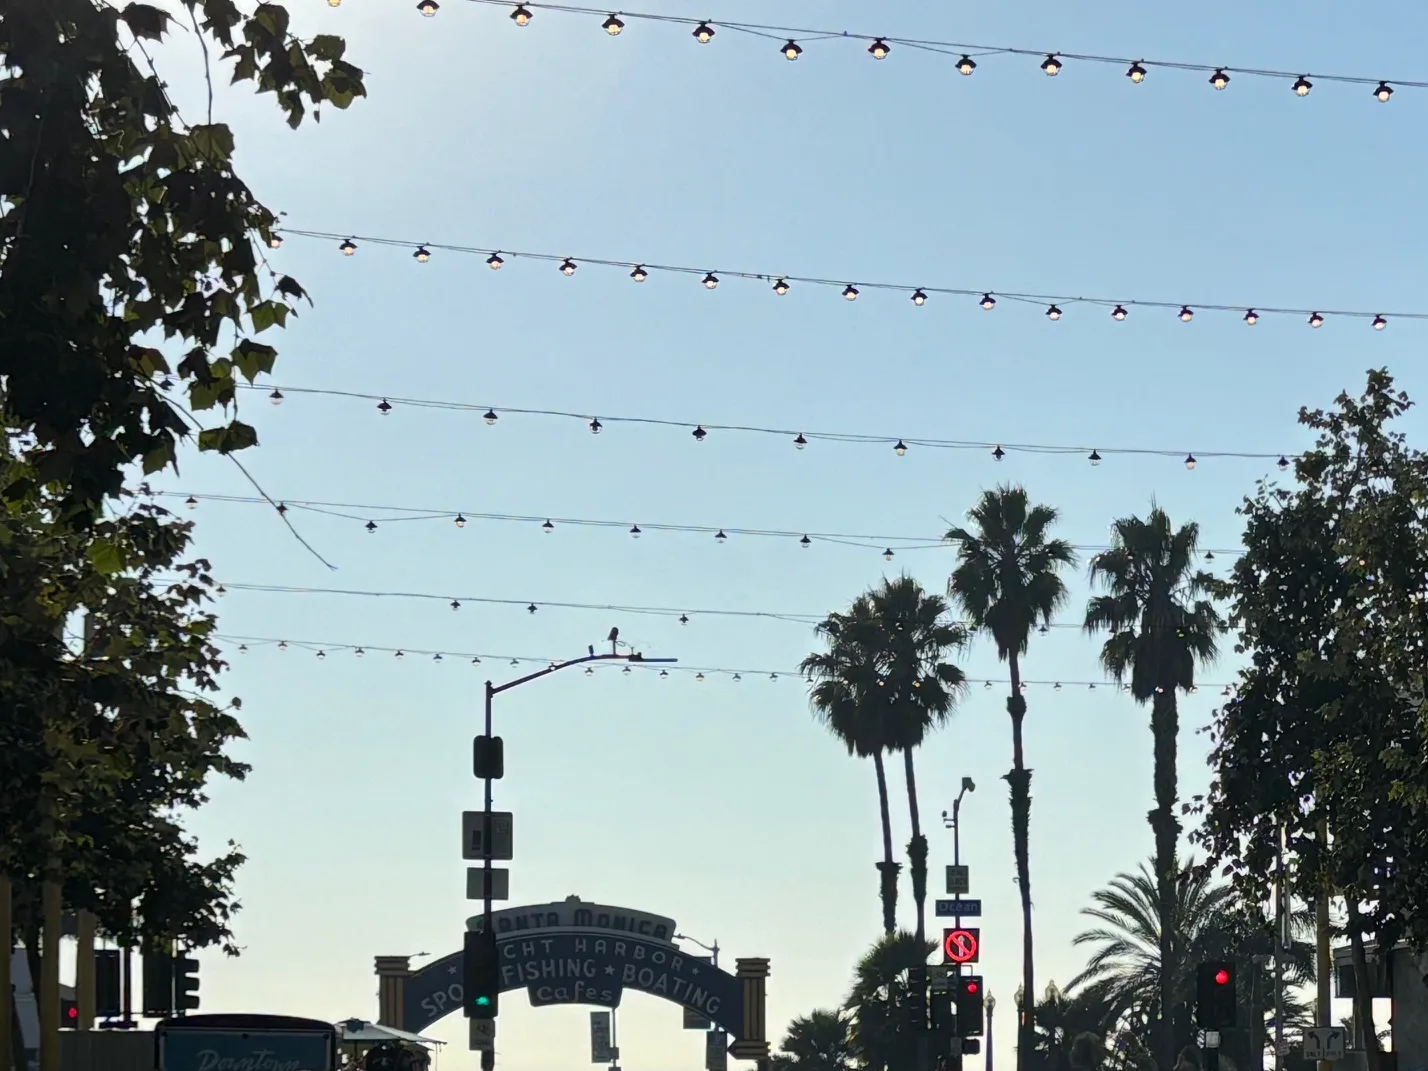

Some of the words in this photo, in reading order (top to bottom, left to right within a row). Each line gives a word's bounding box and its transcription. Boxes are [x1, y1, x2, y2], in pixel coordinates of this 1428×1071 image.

[939, 901, 978, 912] Ocean
[477, 911, 560, 933] ANTA
[574, 908, 668, 939] MONICA
[503, 939, 554, 959] CHT
[575, 937, 684, 972] HARBOR
[420, 983, 464, 1018] SPO
[501, 958, 597, 985] FISHING
[622, 963, 721, 1014] BOATING
